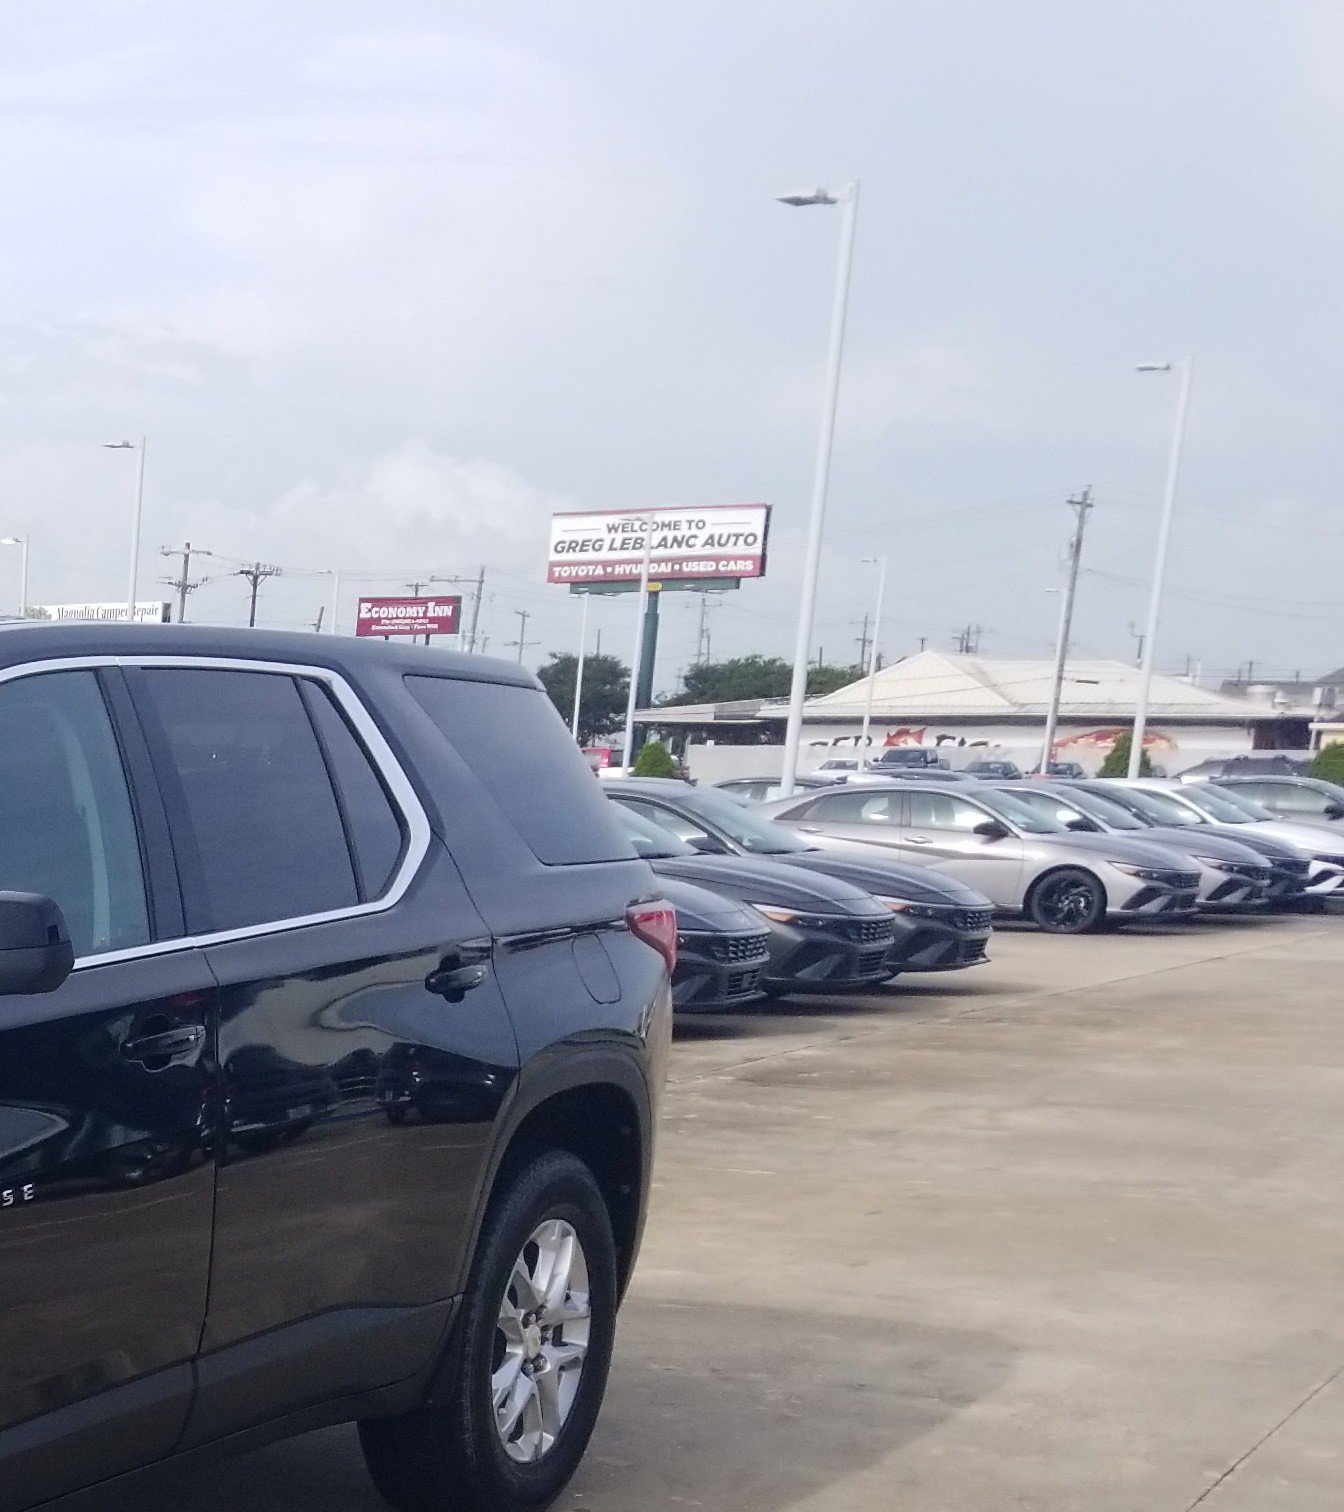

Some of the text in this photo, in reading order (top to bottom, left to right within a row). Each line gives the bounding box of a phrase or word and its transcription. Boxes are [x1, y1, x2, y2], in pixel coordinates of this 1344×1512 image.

[606, 519, 706, 534] WELCOME TO
[553, 532, 758, 554] GREG LEBANC AUTO
[552, 560, 754, 577] TOYOTA HYUDAI USED CARS
